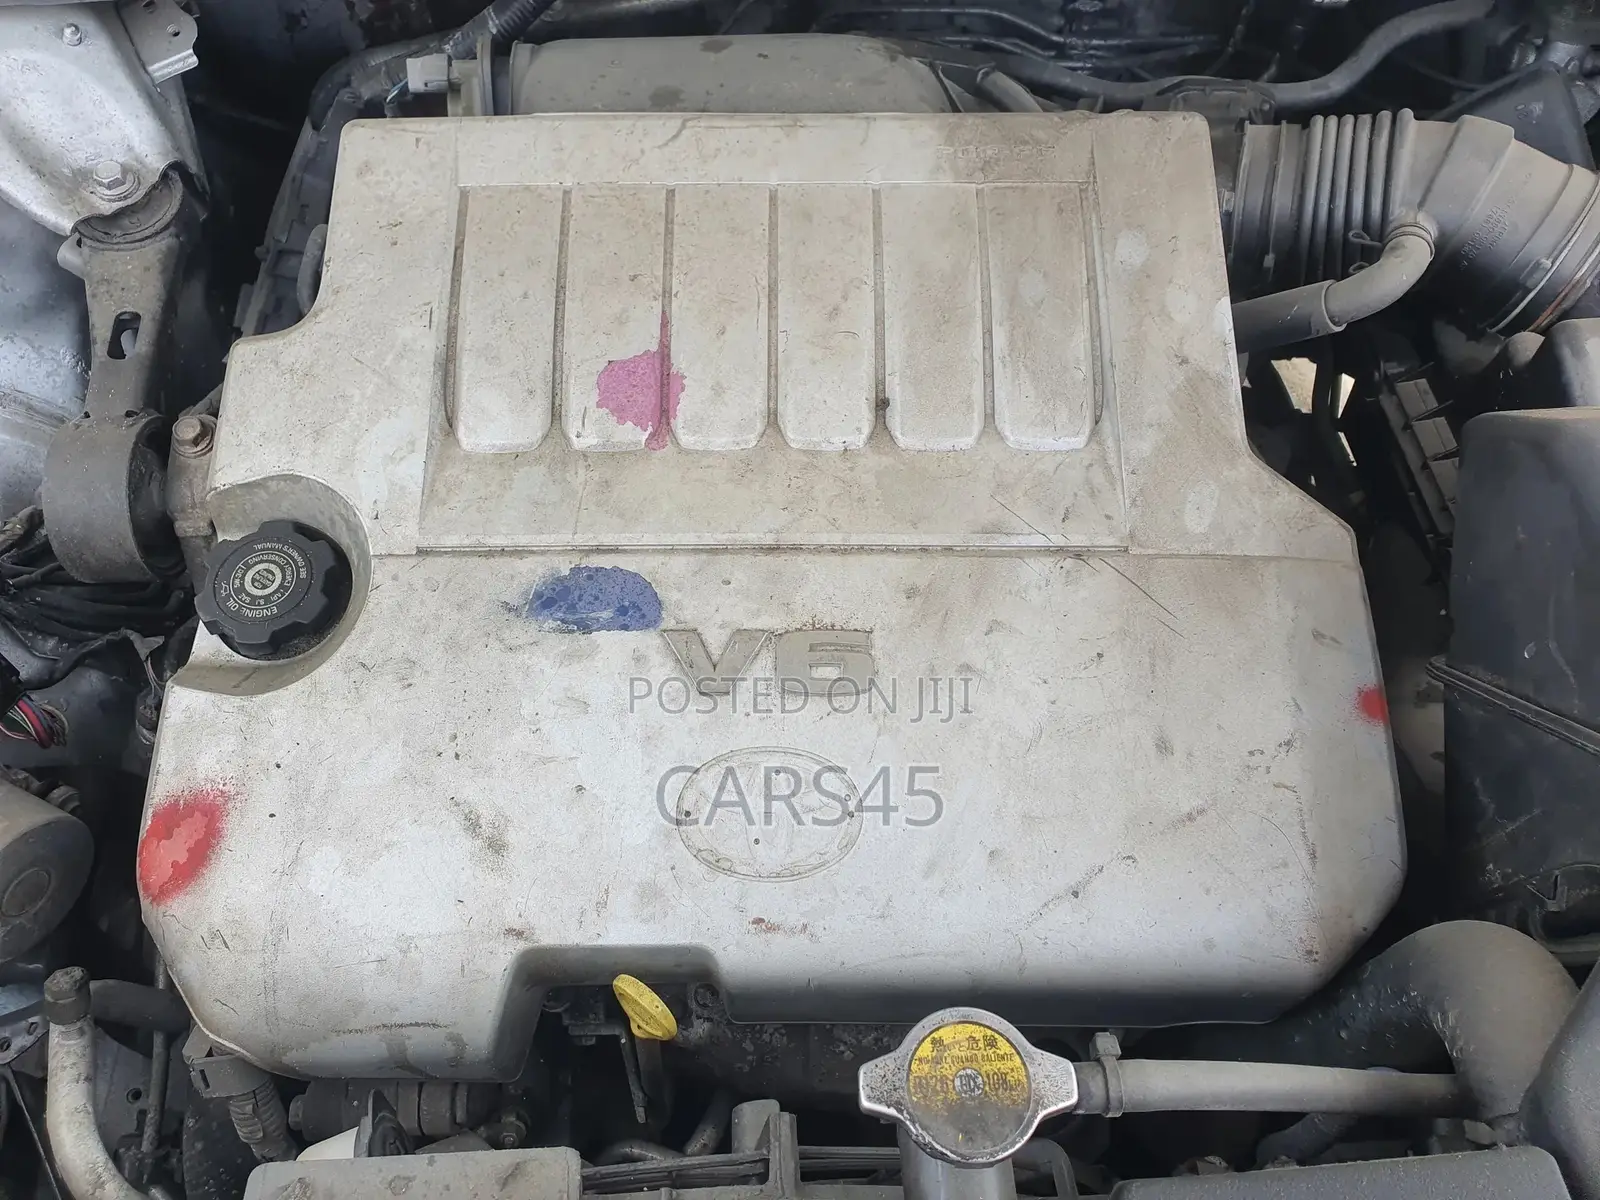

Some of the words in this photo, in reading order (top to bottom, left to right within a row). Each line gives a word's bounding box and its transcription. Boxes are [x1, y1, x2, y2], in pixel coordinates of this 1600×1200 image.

[252, 542, 283, 551] MANUAL
[248, 554, 287, 565] CONSERVING
[282, 545, 305, 567] OWNER'S
[284, 565, 293, 586] ENERGY
[299, 567, 307, 579] SEE
[226, 598, 239, 611] OIL
[240, 606, 278, 618] ENGINE
[660, 628, 877, 697] V6
